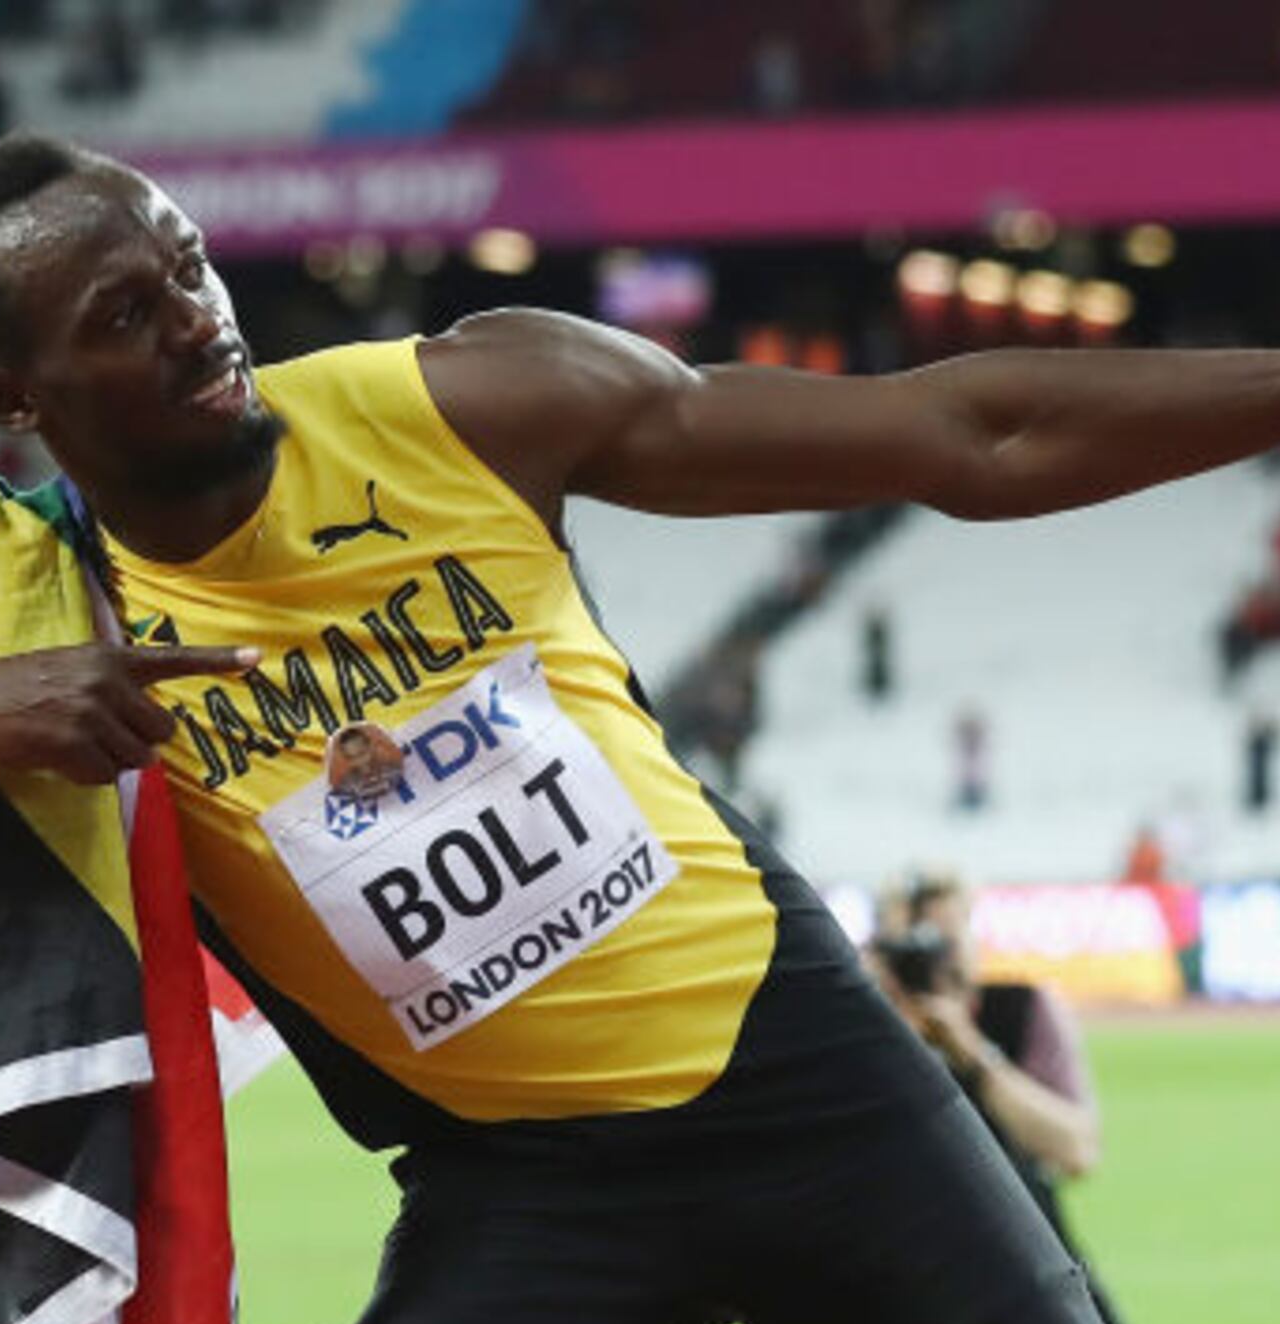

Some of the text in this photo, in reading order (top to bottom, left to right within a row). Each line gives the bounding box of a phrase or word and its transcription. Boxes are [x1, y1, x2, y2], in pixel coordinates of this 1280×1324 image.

[172, 553, 514, 790] JAMAICA
[361, 758, 597, 962] BOLT
[406, 841, 659, 1038] LONDON 2017
